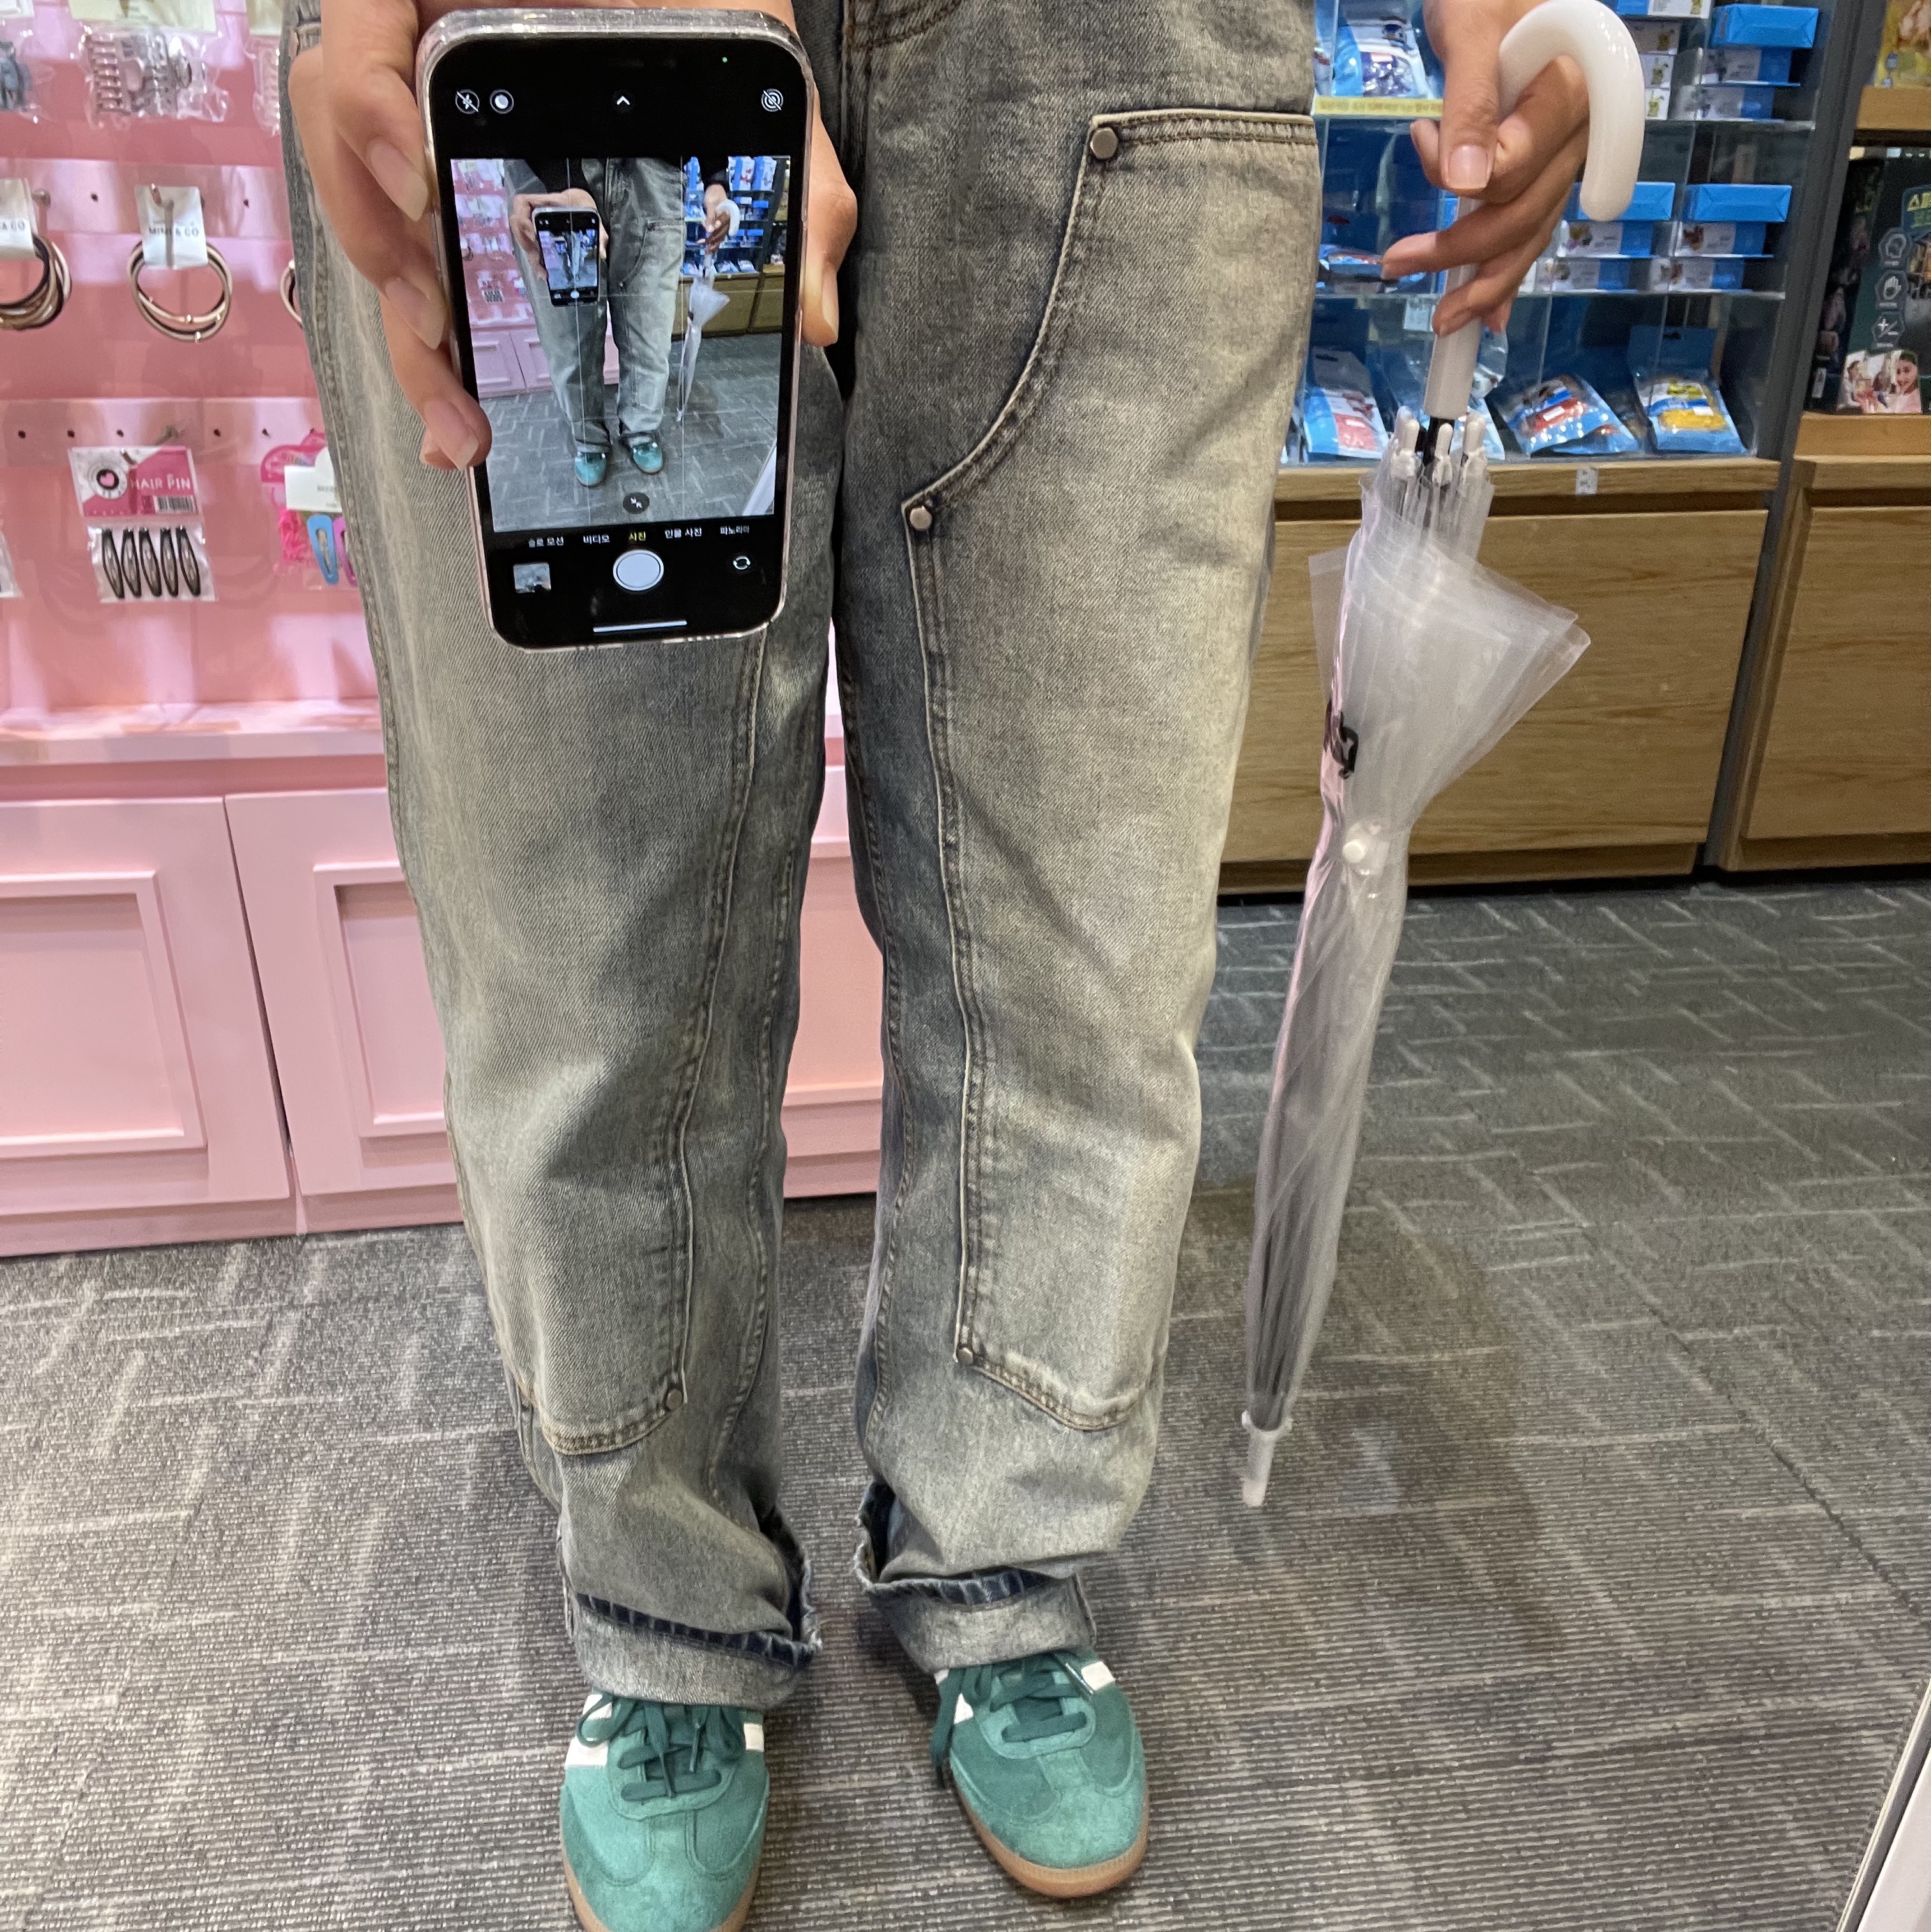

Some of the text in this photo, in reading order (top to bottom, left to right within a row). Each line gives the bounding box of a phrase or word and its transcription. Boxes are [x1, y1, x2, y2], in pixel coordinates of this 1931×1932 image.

[130, 474, 191, 490] HAIR PIN
[629, 531, 646, 542] 사진
[685, 527, 702, 537] 사진
[583, 534, 611, 544] 비디오
